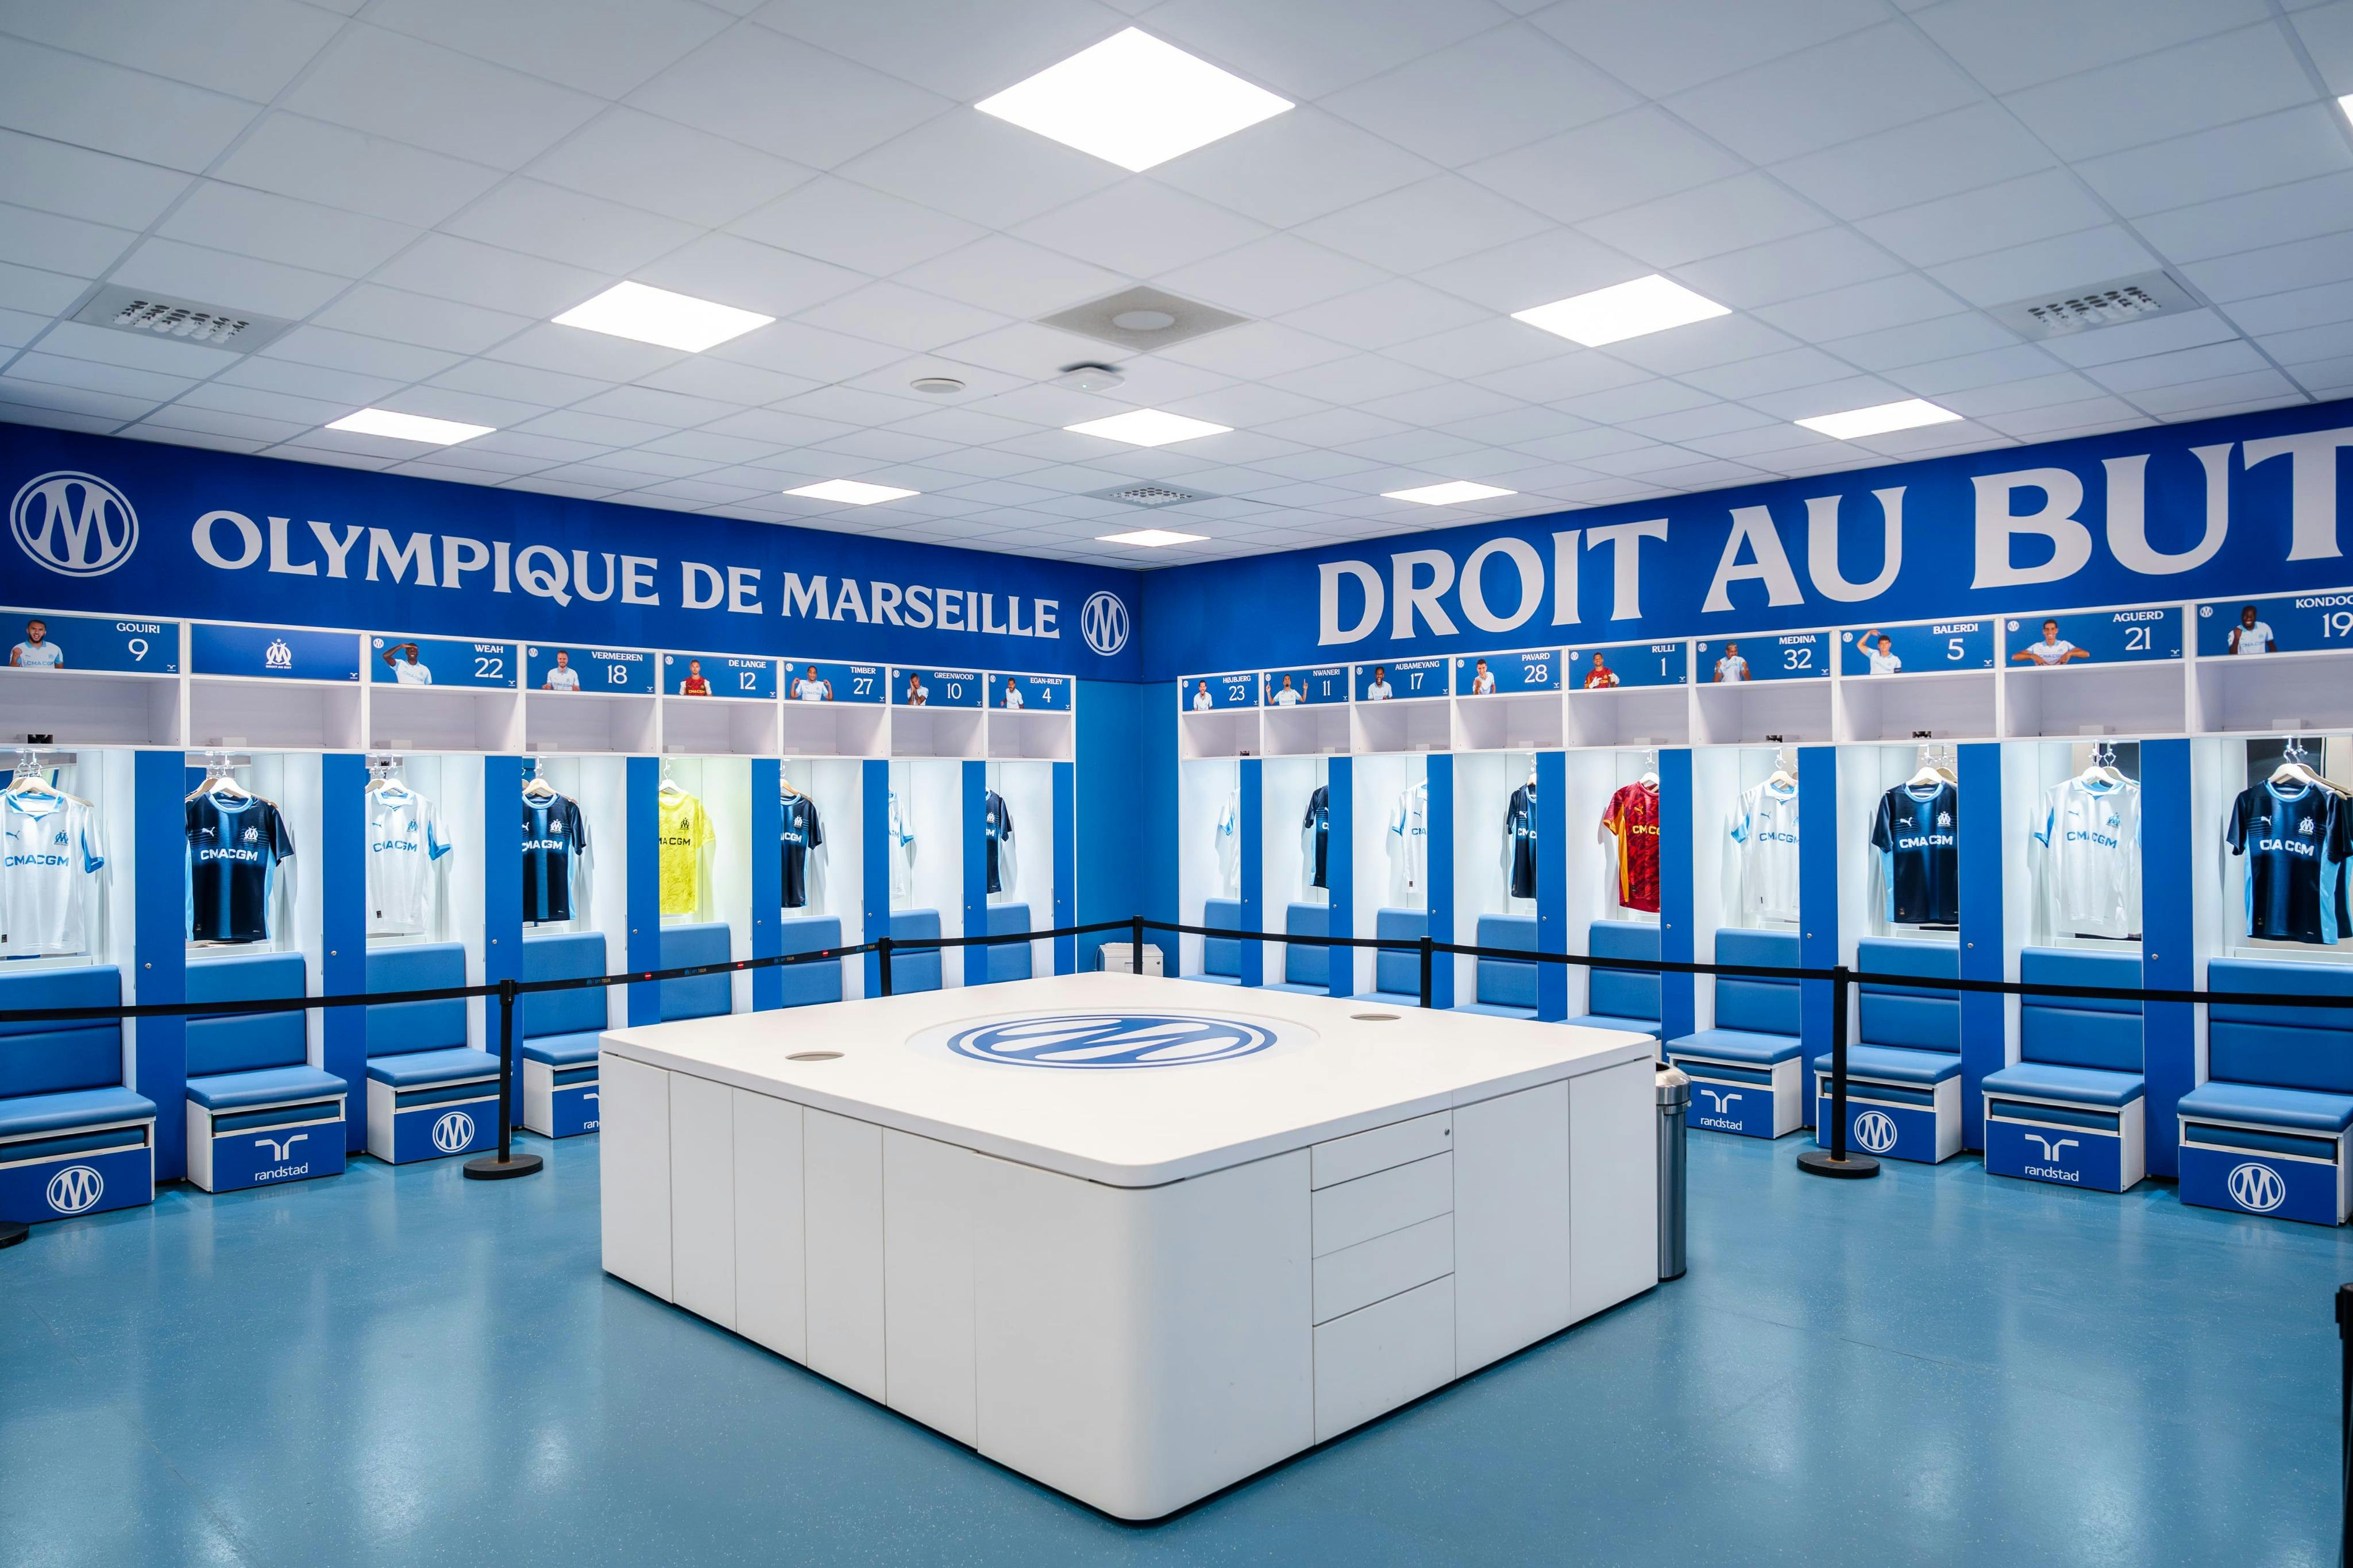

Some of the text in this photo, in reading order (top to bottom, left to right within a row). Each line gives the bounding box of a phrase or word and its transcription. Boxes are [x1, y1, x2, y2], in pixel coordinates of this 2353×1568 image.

[1317, 427, 2353, 646] DROIT AU BUT
[192, 510, 1060, 639] OLYMPIQUE DE MARSEILLE
[2112, 611, 2164, 623] AGUERD
[2322, 611, 2353, 638] 19
[117, 623, 160, 634] GOUIRI
[1933, 623, 1978, 634] BALERDI
[1779, 635, 1816, 644] MEDINA
[2125, 626, 2151, 651] 21
[128, 639, 149, 661] 9
[475, 644, 503, 654] WEAH
[592, 651, 643, 661] VERMEEREN
[1522, 652, 1550, 661] PAVARD
[1652, 644, 1675, 653] RULLI
[1947, 638, 1964, 660] 5
[741, 661, 766, 669] LANGE
[1395, 661, 1440, 670] AUBAMEYANG
[1661, 657, 1666, 676] 1
[1784, 648, 1812, 670] 32
[475, 658, 503, 678] 22
[608, 665, 627, 684] 18
[850, 666, 876, 674] TIMBER
[934, 672, 974, 680] GREENWOOD
[1313, 669, 1340, 677] NWANERI
[1524, 664, 1548, 683] 28
[739, 672, 756, 690] 12
[854, 678, 873, 695] 27
[1223, 675, 1251, 683] HØJBJERG
[1410, 673, 1424, 690] 17
[947, 683, 962, 699] 10
[1042, 688, 1051, 702] 4
[1229, 685, 1245, 701] 23
[1323, 680, 1330, 696] 11
[1700, 1115, 1742, 1130] randstad
[254, 1162, 308, 1181] randstad
[2024, 1165, 2079, 1182] randstad
